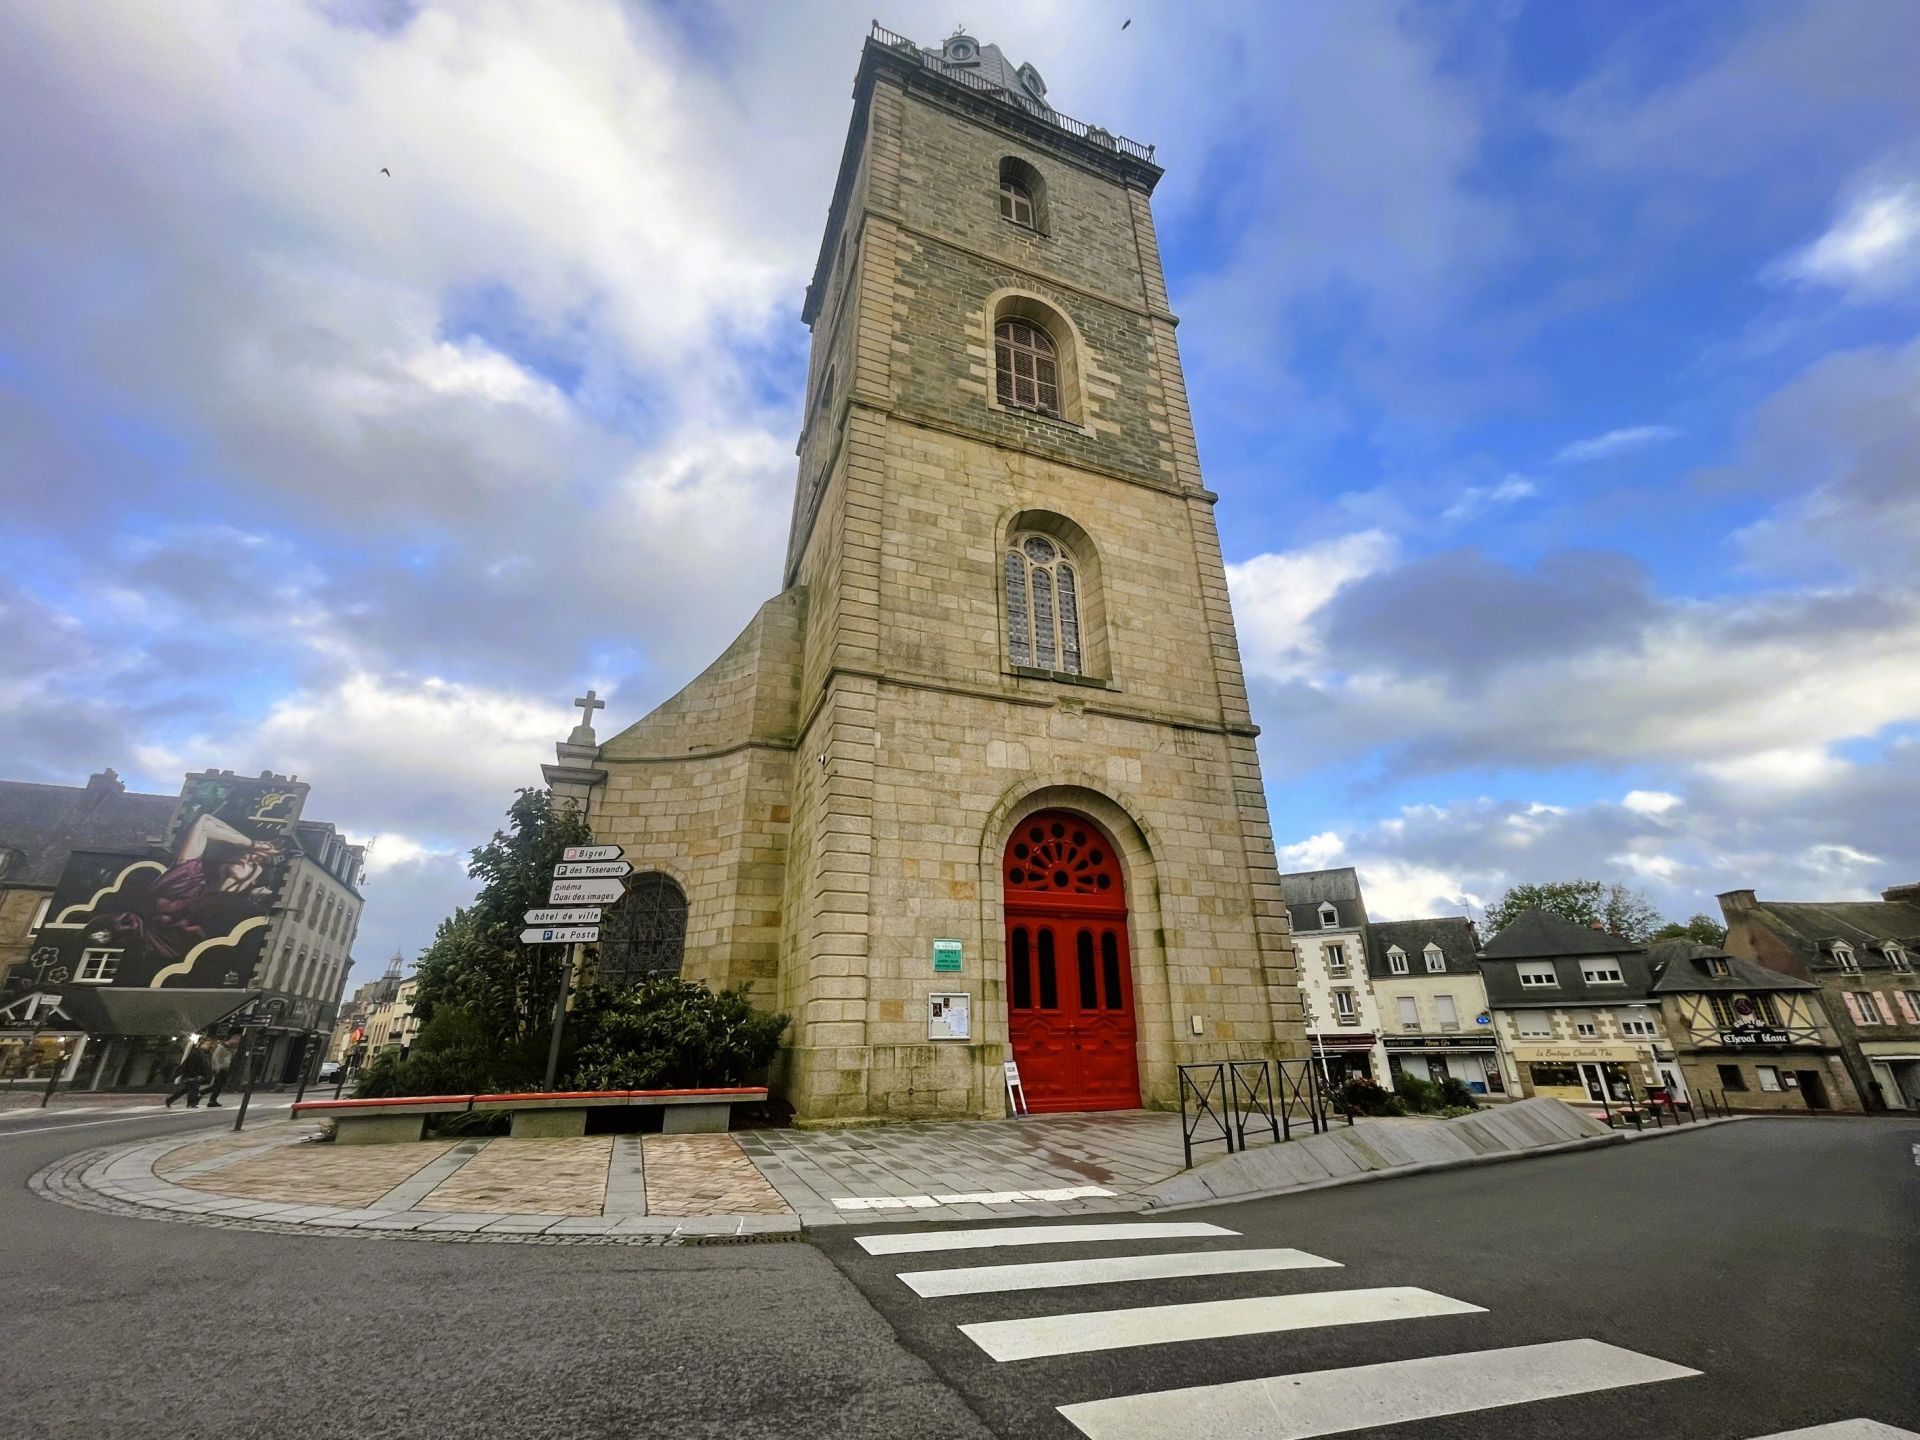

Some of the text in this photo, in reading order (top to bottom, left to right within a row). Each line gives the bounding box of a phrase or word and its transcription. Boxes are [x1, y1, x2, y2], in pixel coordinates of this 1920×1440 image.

[579, 850, 607, 859] Bigrel
[569, 866, 582, 874] des
[585, 864, 624, 873] Tisserands
[555, 883, 582, 891] cinéma
[553, 893, 571, 901] Quai
[587, 893, 614, 902] images
[578, 912, 599, 920] ville
[555, 931, 565, 939] La
[570, 930, 596, 939] Poste
[1536, 1048, 1544, 1057] La
